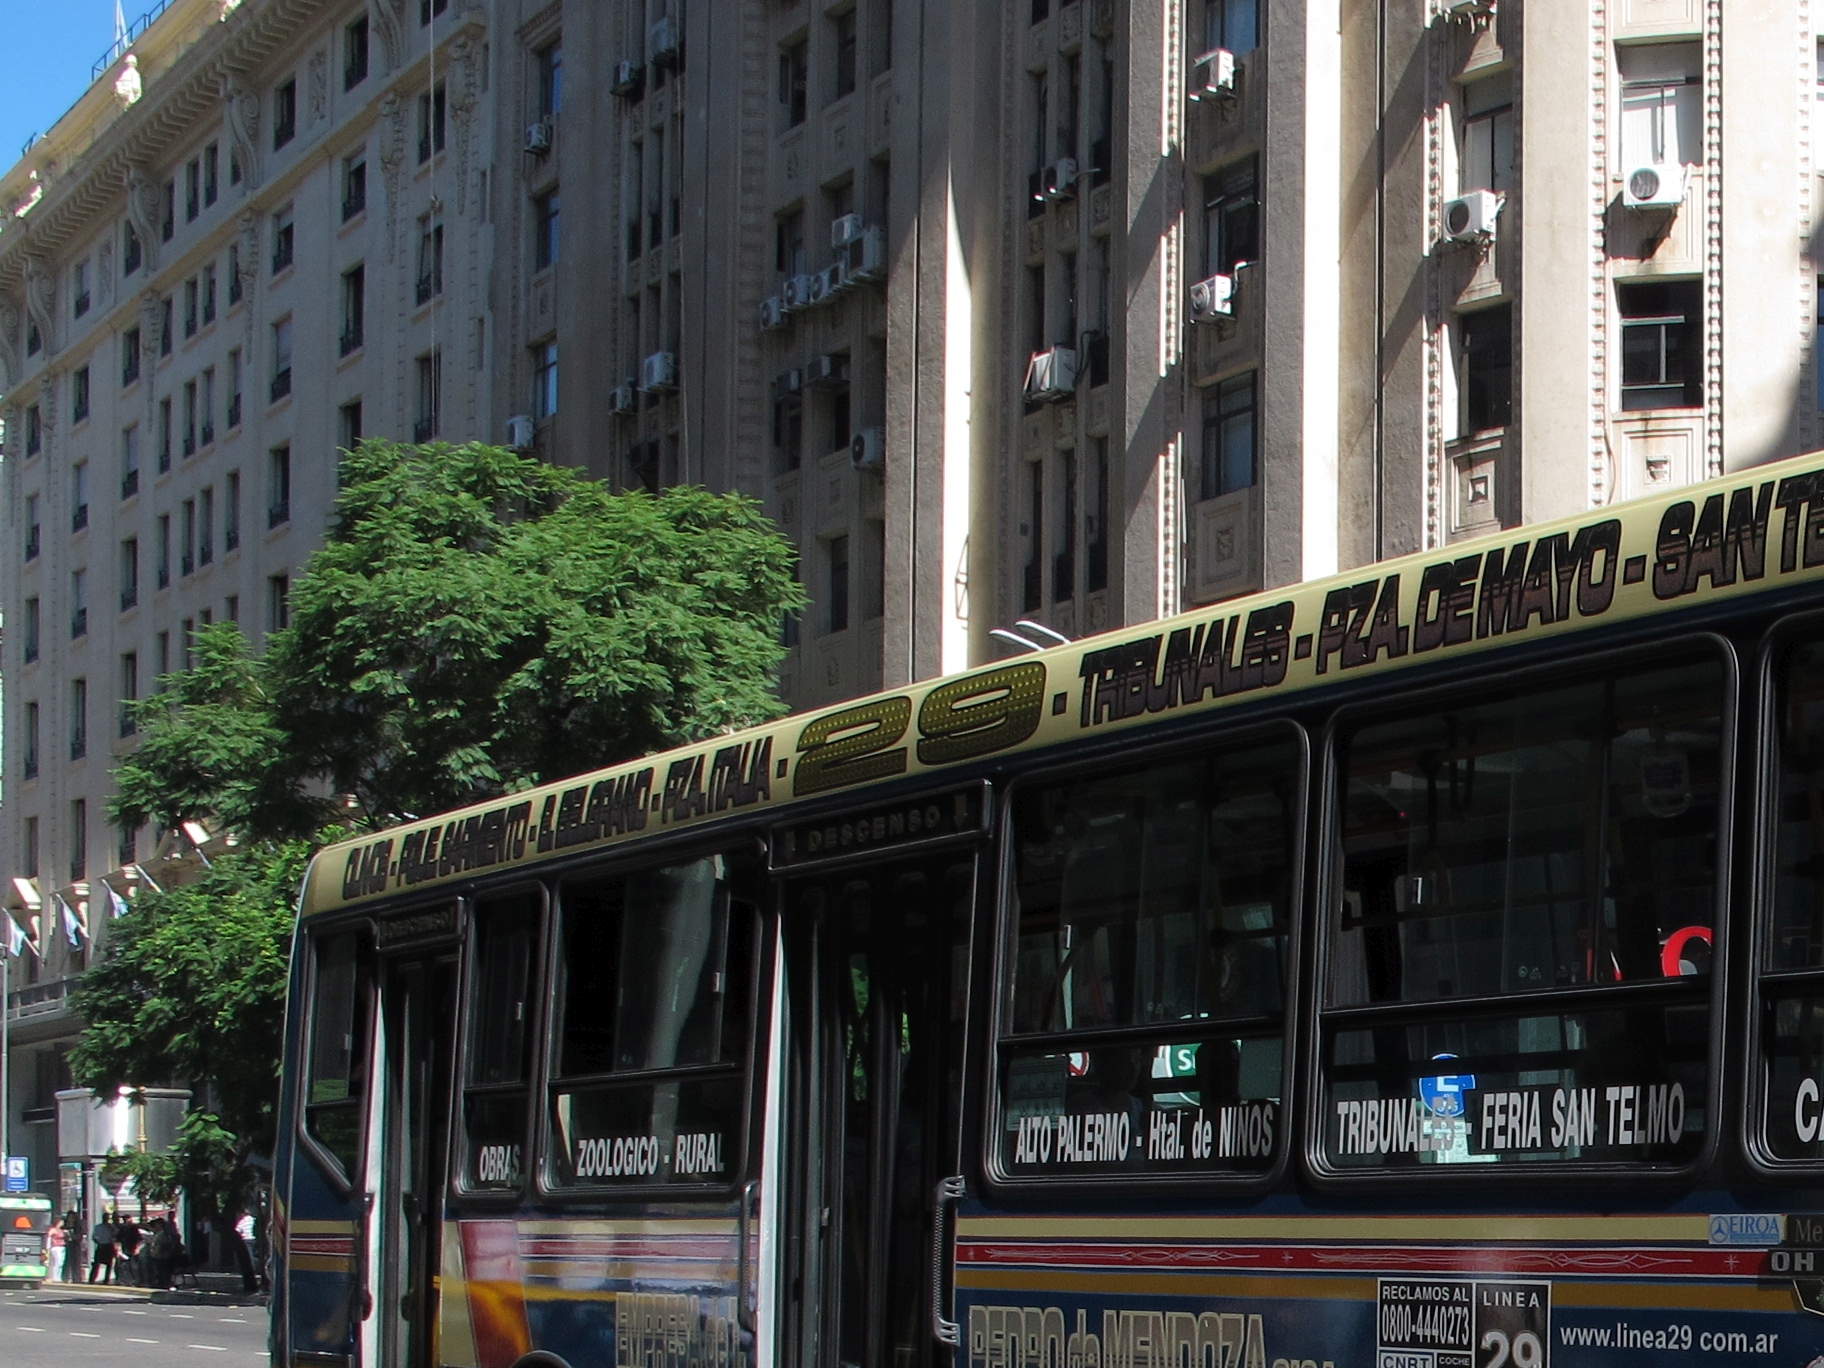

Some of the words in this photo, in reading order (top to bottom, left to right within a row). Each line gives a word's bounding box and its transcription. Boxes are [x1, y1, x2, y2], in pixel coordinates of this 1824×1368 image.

[706, 735, 771, 814] ITALIA
[793, 660, 1046, 798] 29
[1079, 601, 1294, 728] TRIBUNALES
[1413, 552, 1482, 653] DE
[1475, 518, 1622, 640] MAYO
[1652, 480, 1776, 601] SAN
[806, 804, 942, 853] DESCENSO
[1015, 1115, 1052, 1165] ALTO
[1056, 1110, 1131, 1164] PALERMO
[1148, 1108, 1185, 1161] Htal.
[1191, 1107, 1213, 1160] de
[1218, 1099, 1274, 1158] NIÑOS
[1336, 1095, 1456, 1156] TRIBUNALES
[1481, 1089, 1543, 1151] FERIA
[1550, 1086, 1597, 1149] SAN
[1606, 1081, 1686, 1147] TELMO
[479, 1143, 521, 1182] OBRAS
[576, 1135, 660, 1178] ZOOLOGICO
[674, 1132, 726, 1175] RURAL
[1730, 1216, 1779, 1234] EIROA
[1771, 1251, 1815, 1273] OH
[1382, 1285, 1451, 1302] RECLAMOS
[1453, 1287, 1470, 1302] AL
[1483, 1291, 1540, 1308] LINEA
[1382, 1303, 1470, 1346] 0800-4440273
[1438, 1356, 1471, 1367] COCHE
